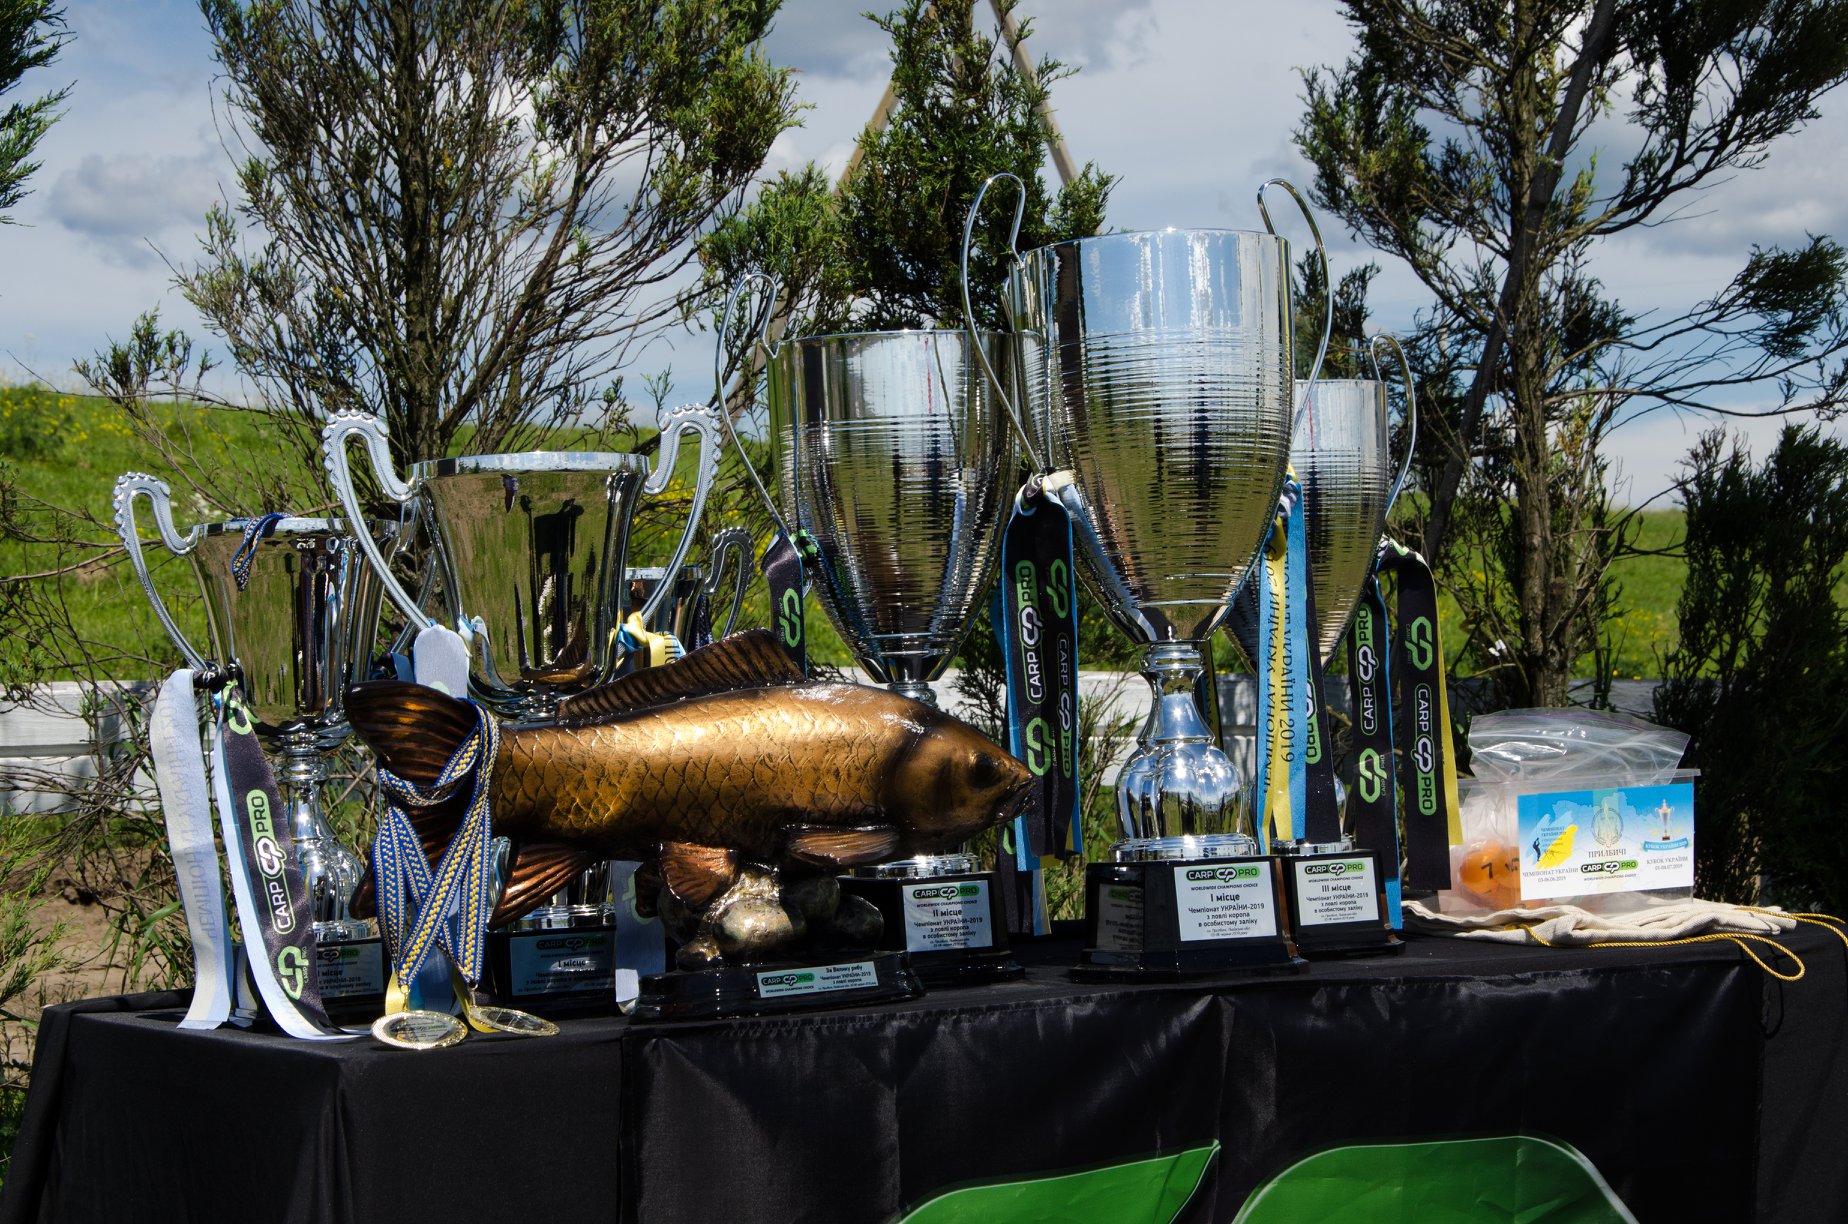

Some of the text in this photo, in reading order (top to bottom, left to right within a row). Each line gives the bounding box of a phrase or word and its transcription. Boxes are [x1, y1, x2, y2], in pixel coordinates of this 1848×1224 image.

[1019, 566, 1033, 603] PRO
[1266, 591, 1280, 674] УКРАЇНИ
[1358, 608, 1370, 641] PRO
[1027, 651, 1043, 698] CARP
[1059, 639, 1068, 686] CARP
[1363, 687, 1374, 730] CARP
[1418, 689, 1429, 732] CARP
[1263, 678, 1276, 794] ЧЕМПІОНАТ
[1279, 718, 1296, 763] 2019
[1063, 735, 1071, 773] PRO
[1421, 777, 1433, 810] PRO
[251, 795, 269, 833] PRO
[1582, 864, 1602, 872] CARP
[1588, 848, 1627, 858] ПРИЛБИЧІ
[1188, 871, 1214, 880] CARP
[1238, 868, 1258, 876] PRO
[1306, 866, 1327, 874] CARP
[915, 890, 937, 898] CARP
[1216, 893, 1240, 902] місце
[1331, 884, 1351, 892] місце
[269, 881, 291, 929] CARP
[940, 909, 962, 917] місце
[1188, 903, 1265, 914] Чемпіонат УКРАЇНИ-2019
[1228, 912, 1250, 920] коропа
[538, 941, 562, 949] CARP
